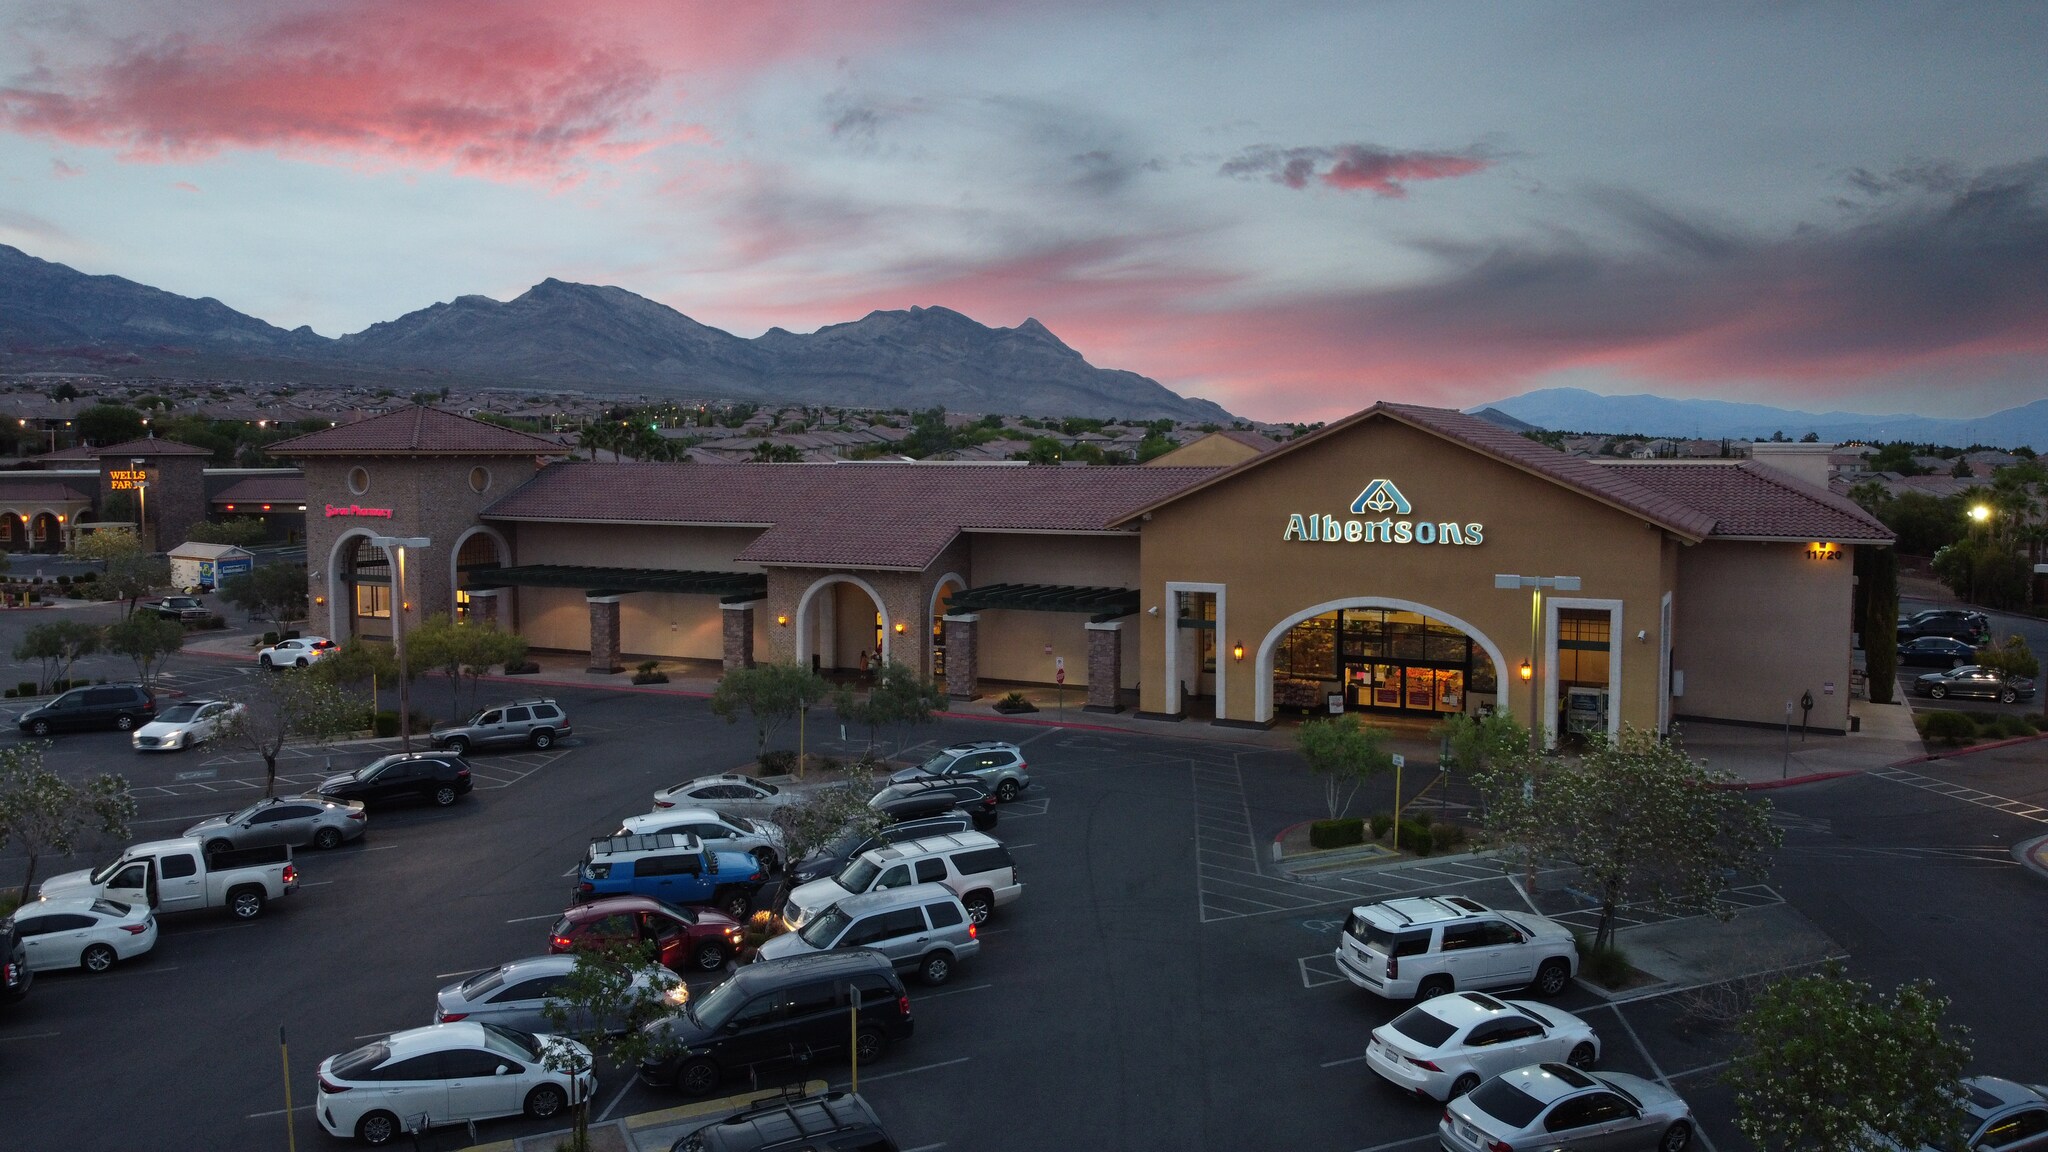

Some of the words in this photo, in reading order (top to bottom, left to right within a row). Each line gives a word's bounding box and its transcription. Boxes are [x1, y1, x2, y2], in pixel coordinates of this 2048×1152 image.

[109, 470, 146, 480] WELLS
[350, 504, 394, 519] Pharmacy
[1283, 513, 1484, 546] Albertsons
[1805, 549, 1842, 560] 11720
